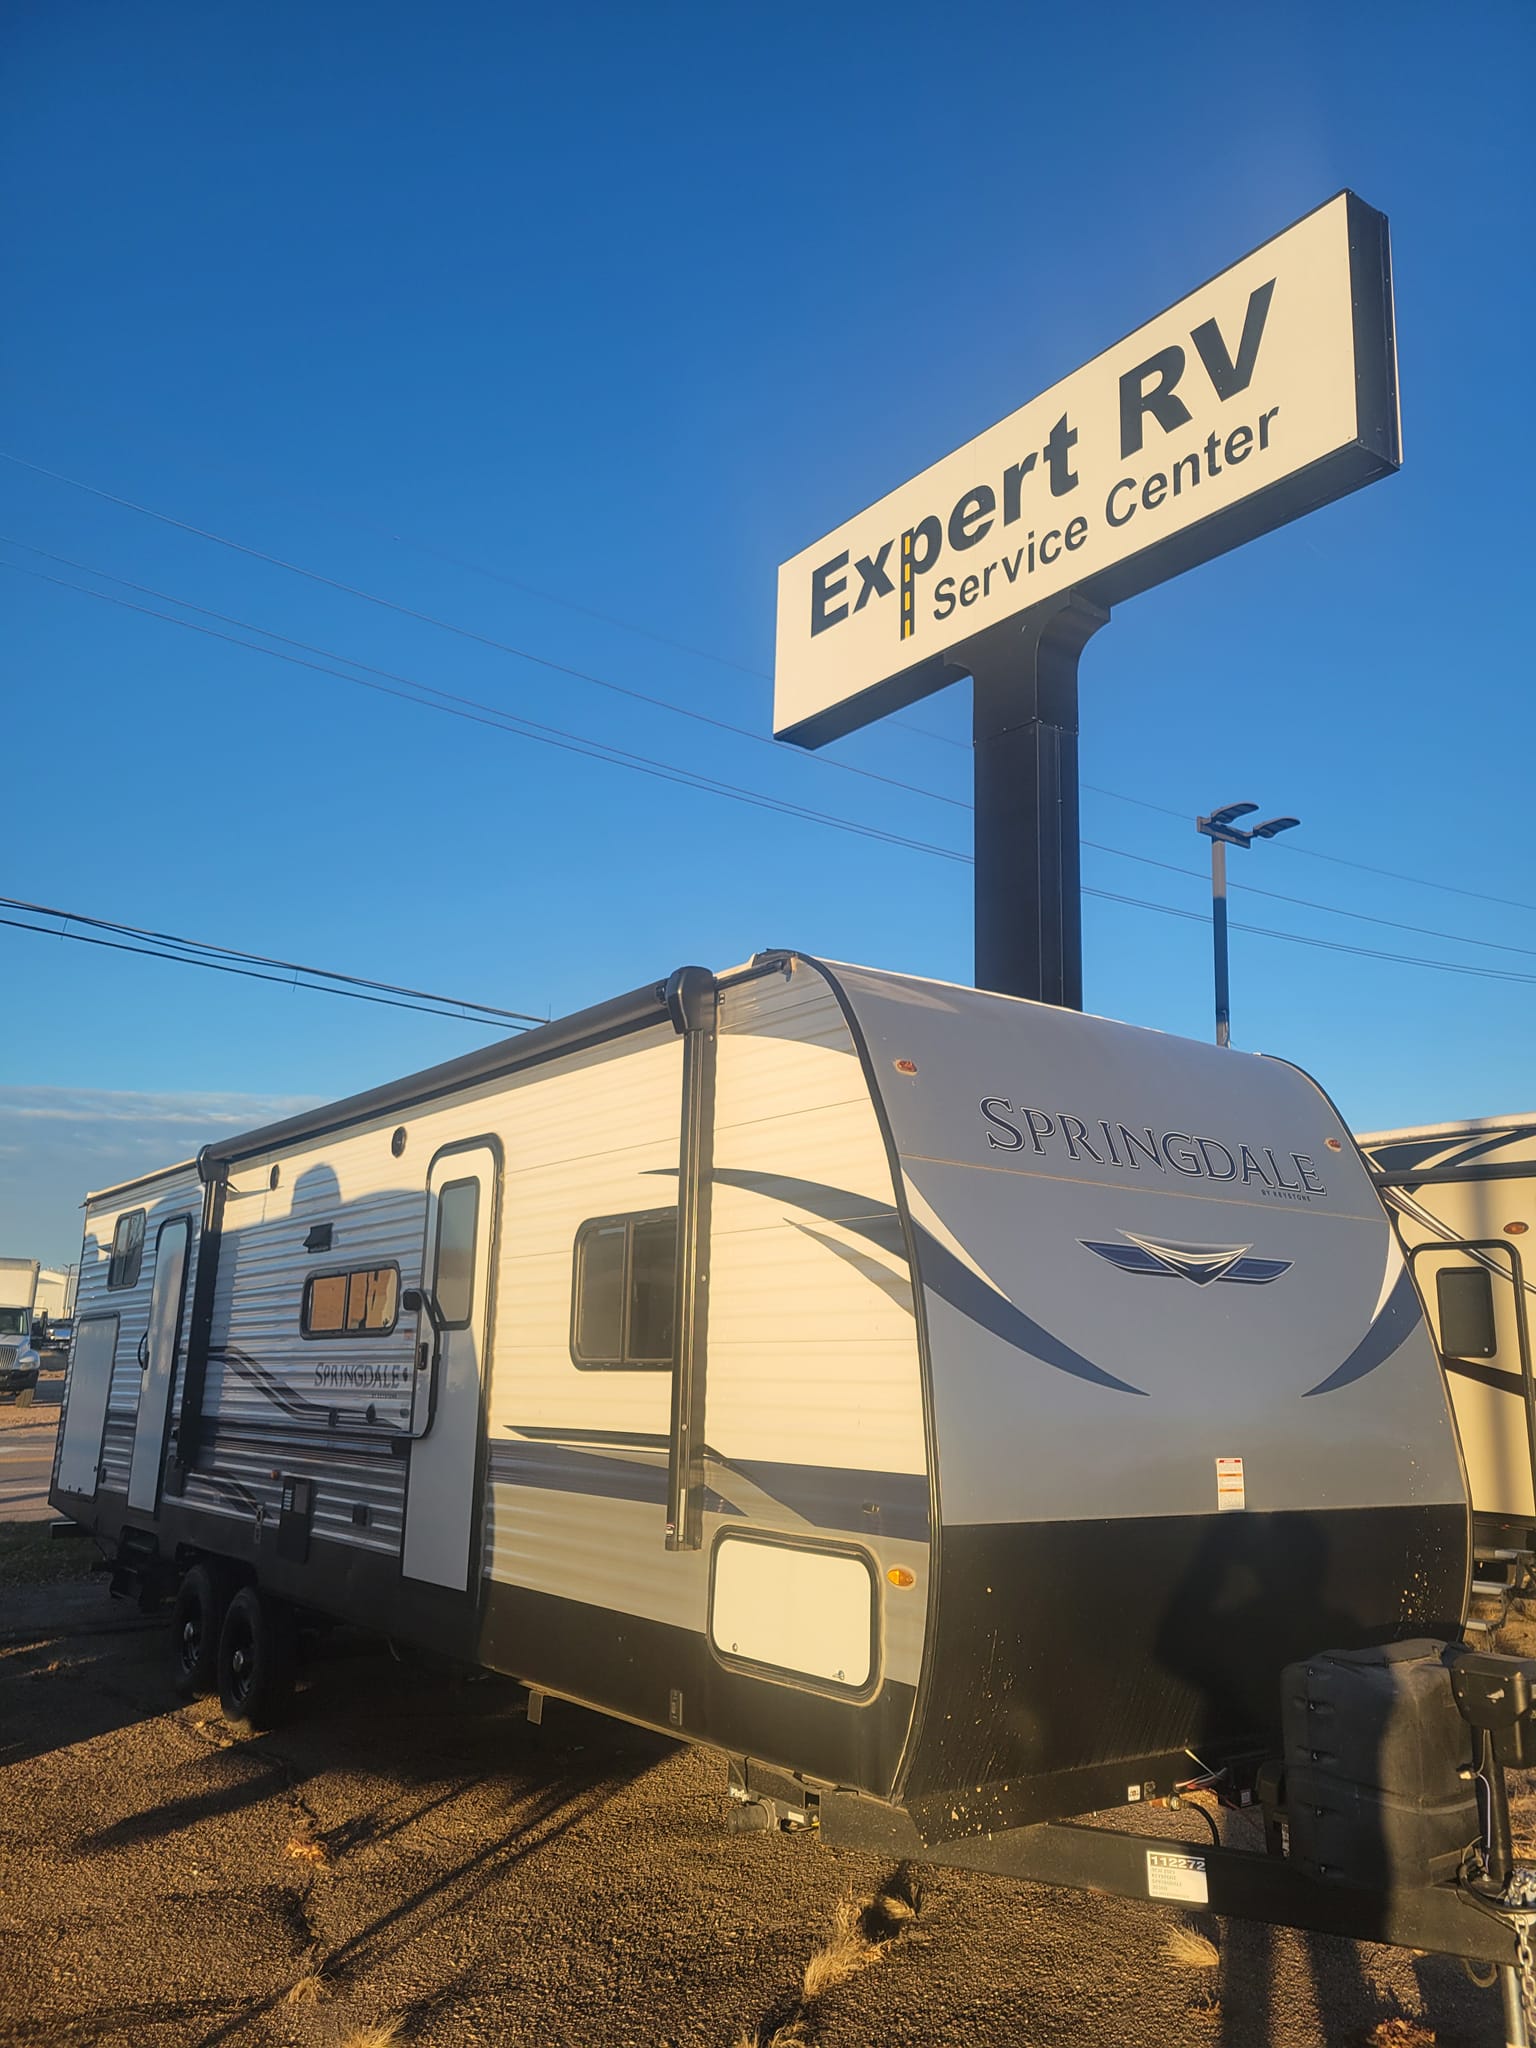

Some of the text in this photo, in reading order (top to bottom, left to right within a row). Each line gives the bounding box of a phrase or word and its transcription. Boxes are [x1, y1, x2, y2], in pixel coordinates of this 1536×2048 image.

[810, 276, 1277, 641] Expert RV
[933, 406, 1280, 621] Service Center
[979, 1095, 1327, 1196] SPRINGDALE
[314, 1362, 400, 1389] SPRINGDALE
[1151, 1855, 1206, 1871] 112272
